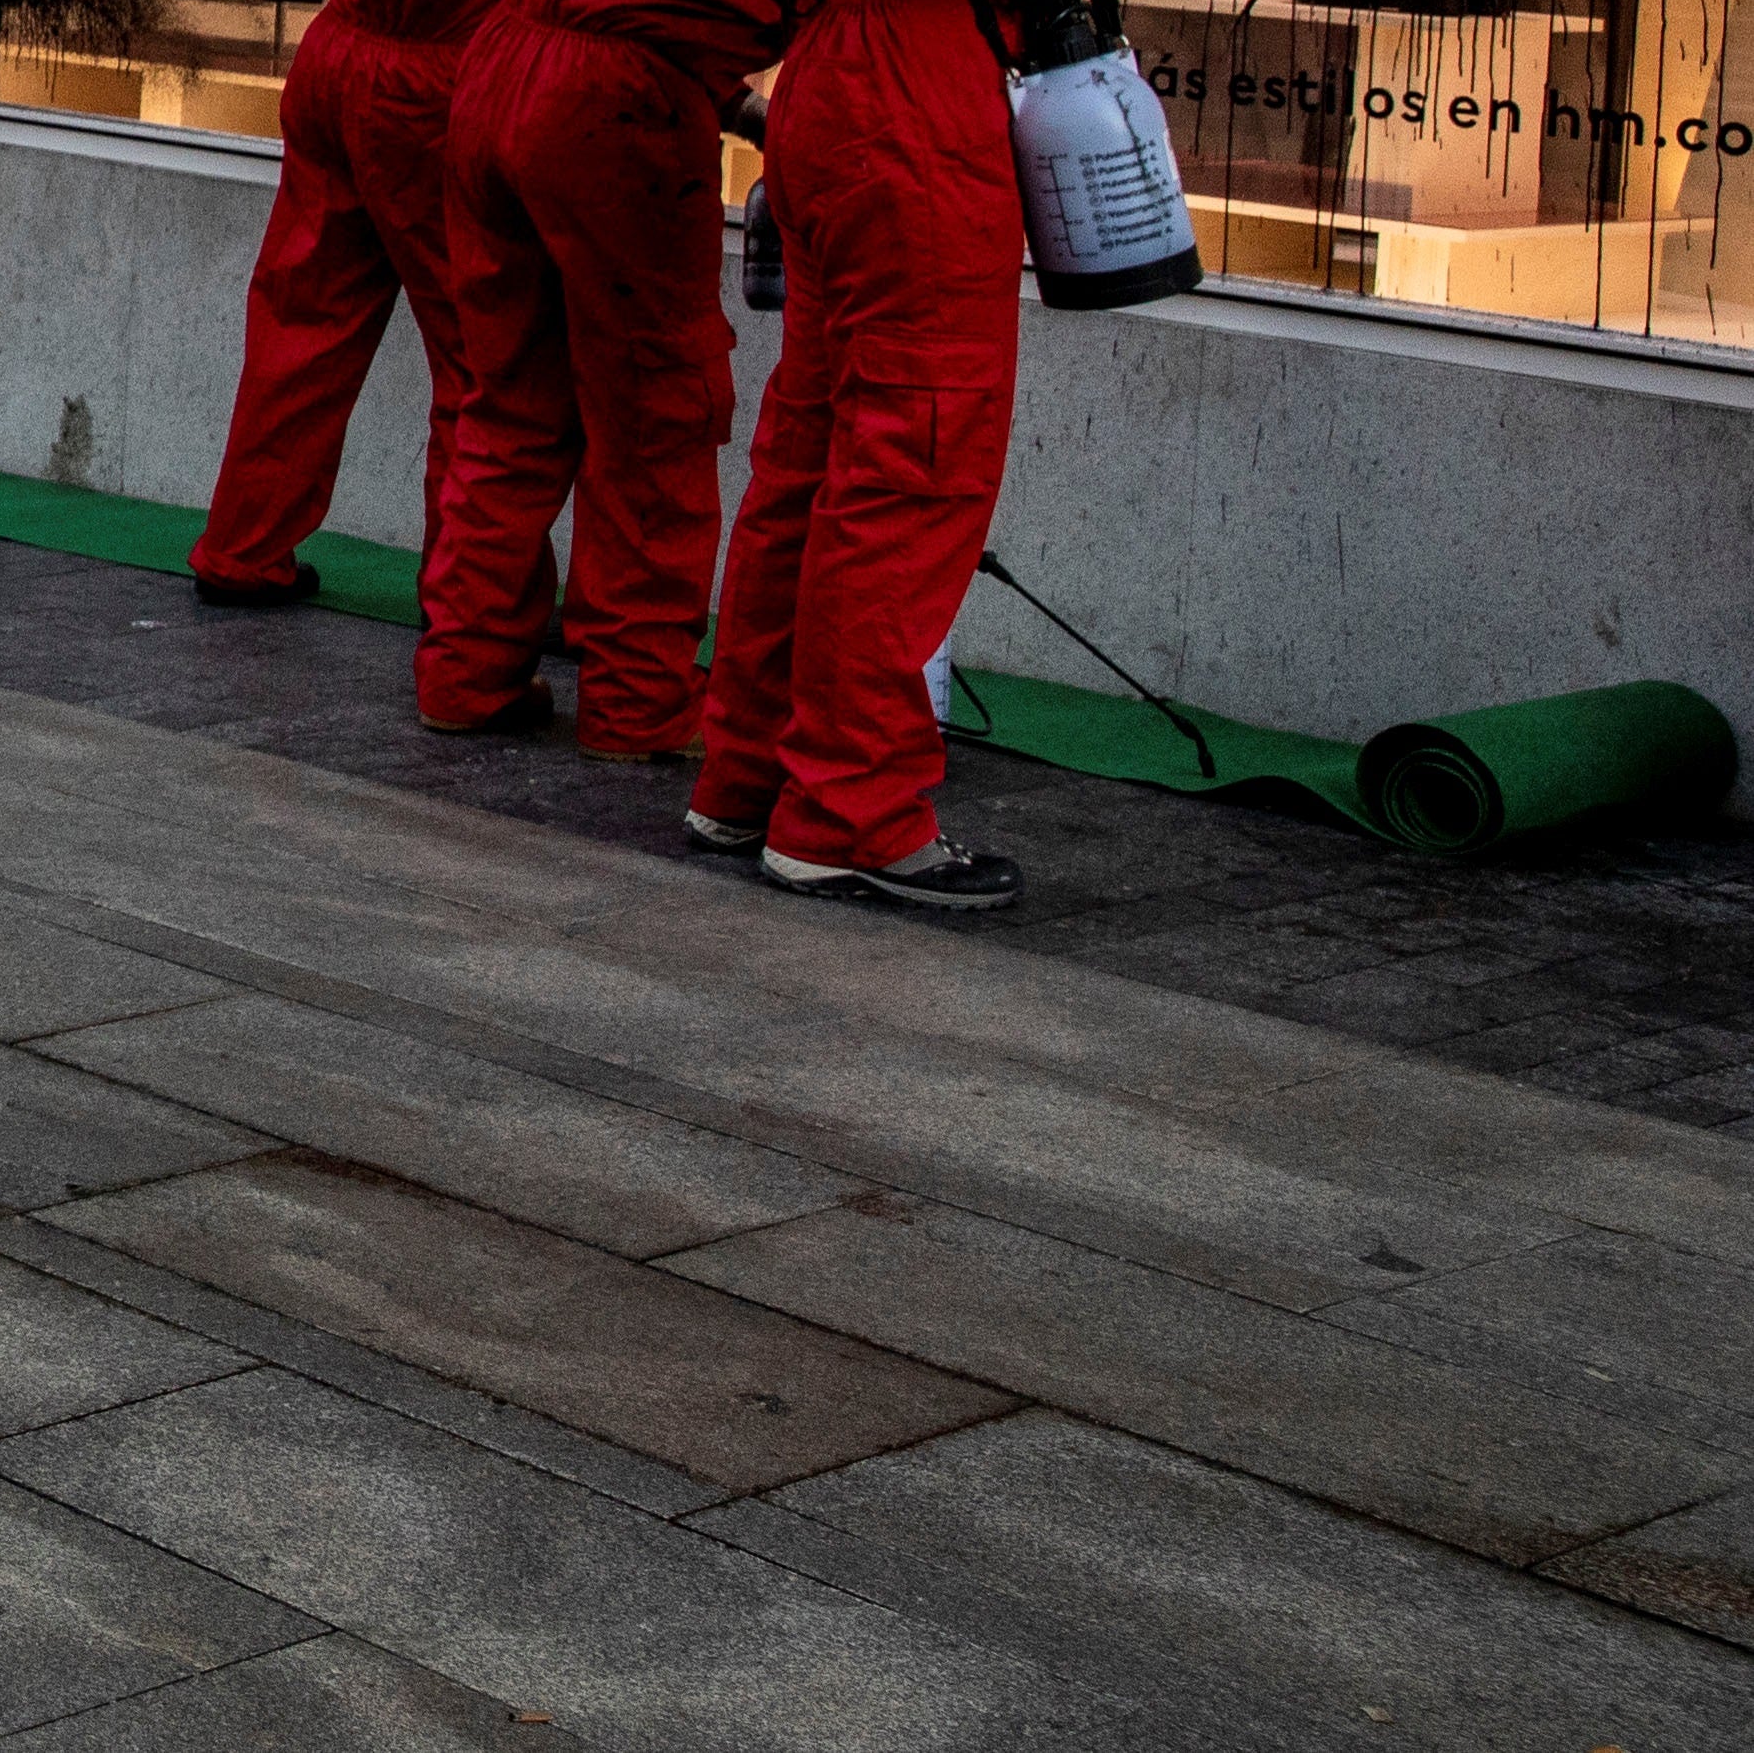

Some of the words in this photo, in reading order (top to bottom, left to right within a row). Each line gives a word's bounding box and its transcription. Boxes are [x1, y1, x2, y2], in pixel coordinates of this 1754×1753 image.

[1136, 50, 1208, 101] ás
[1229, 65, 1426, 123] estilos
[1448, 94, 1521, 134] en
